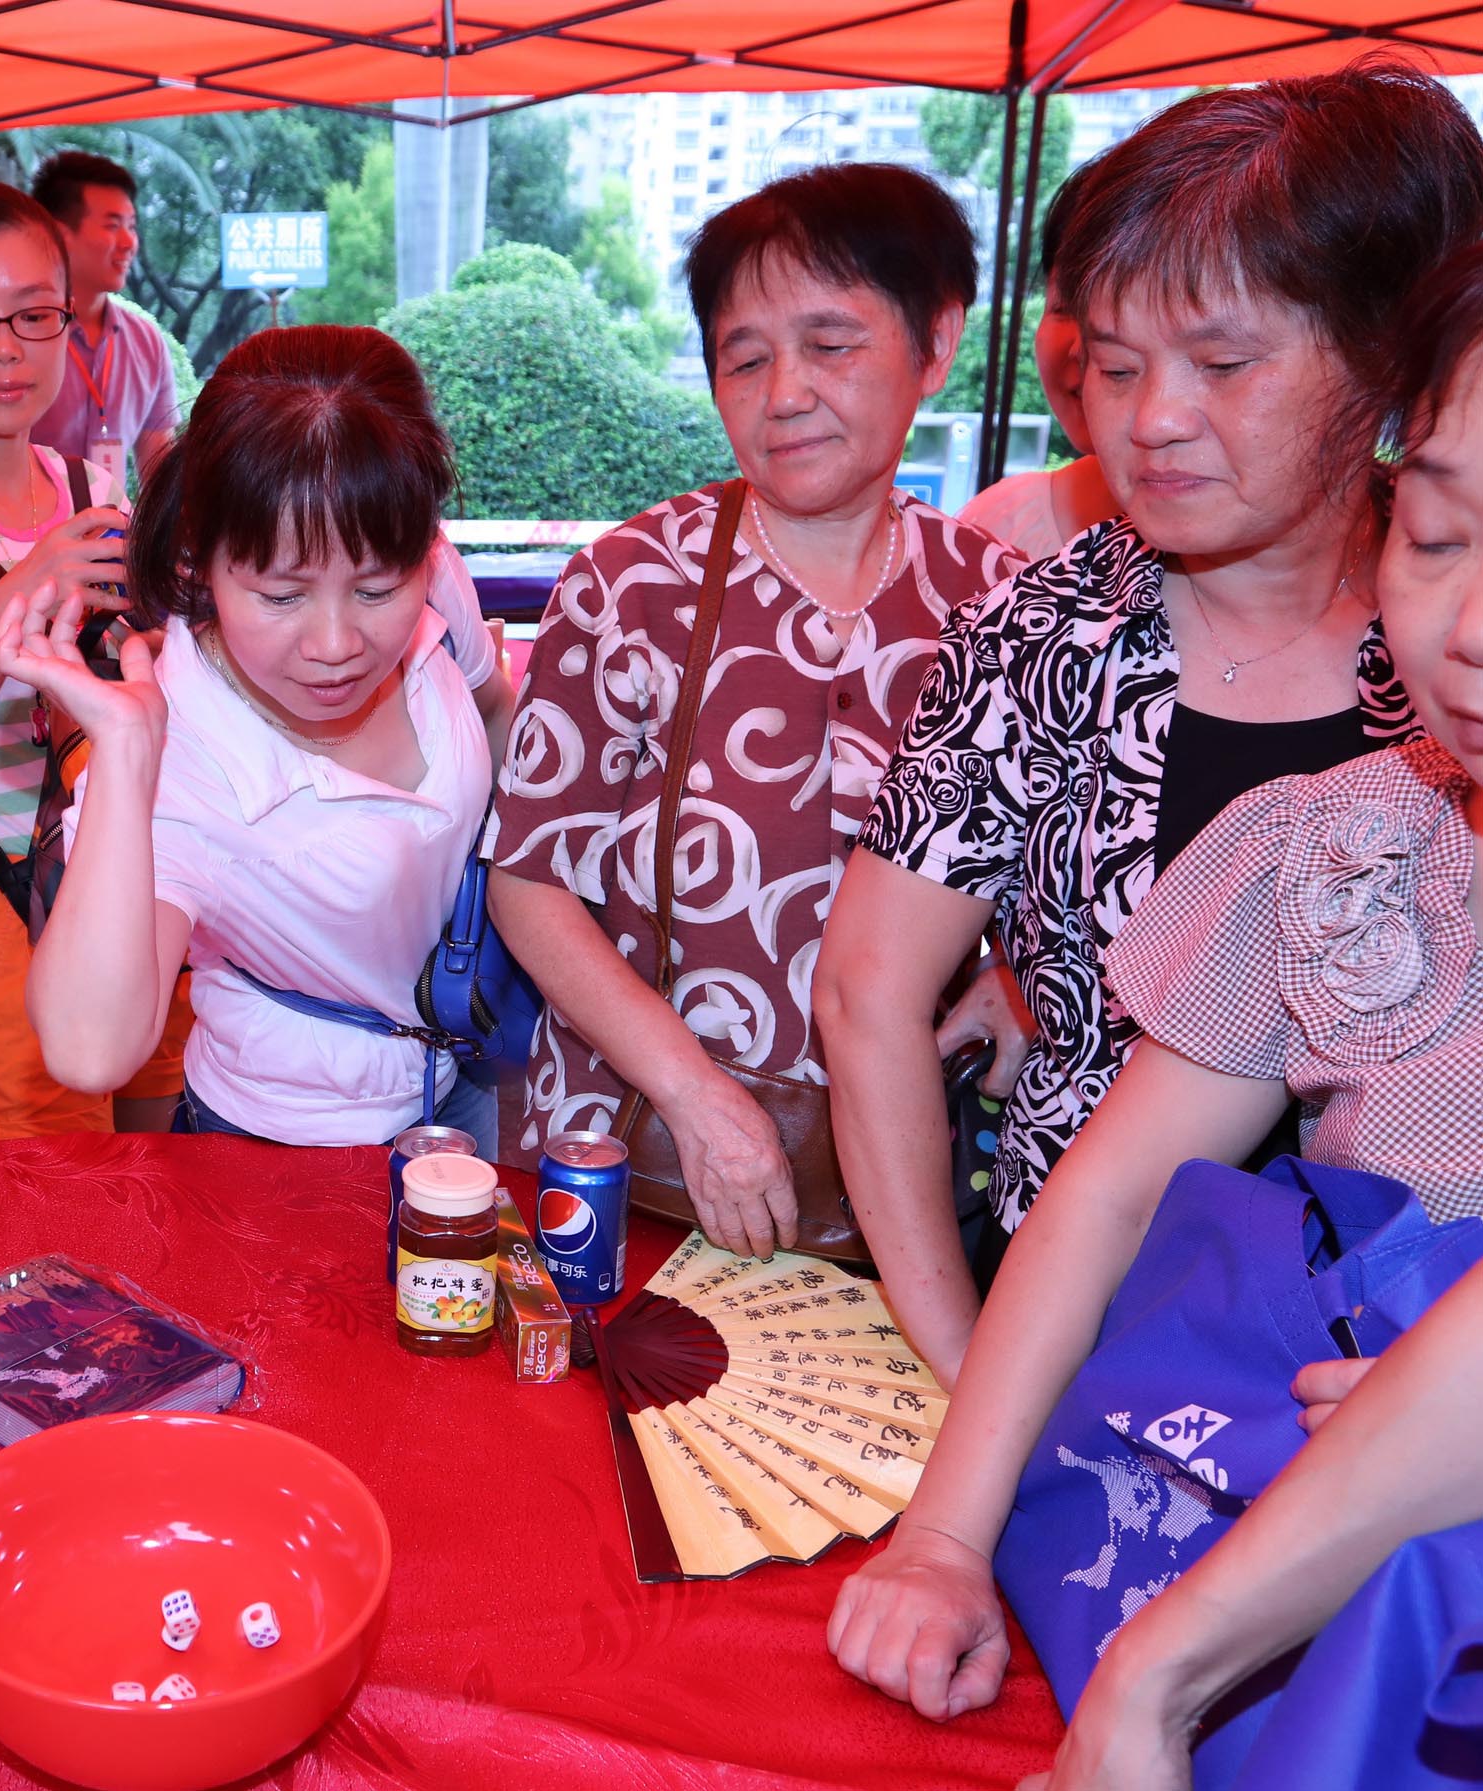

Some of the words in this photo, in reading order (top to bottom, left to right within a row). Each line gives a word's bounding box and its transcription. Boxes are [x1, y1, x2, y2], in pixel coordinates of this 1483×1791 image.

[513, 1243, 543, 1286] Beco
[540, 1253, 588, 1279] 事可乐
[412, 1274, 484, 1293] 枇杷蜂蜜
[534, 1330, 548, 1376] Beco
